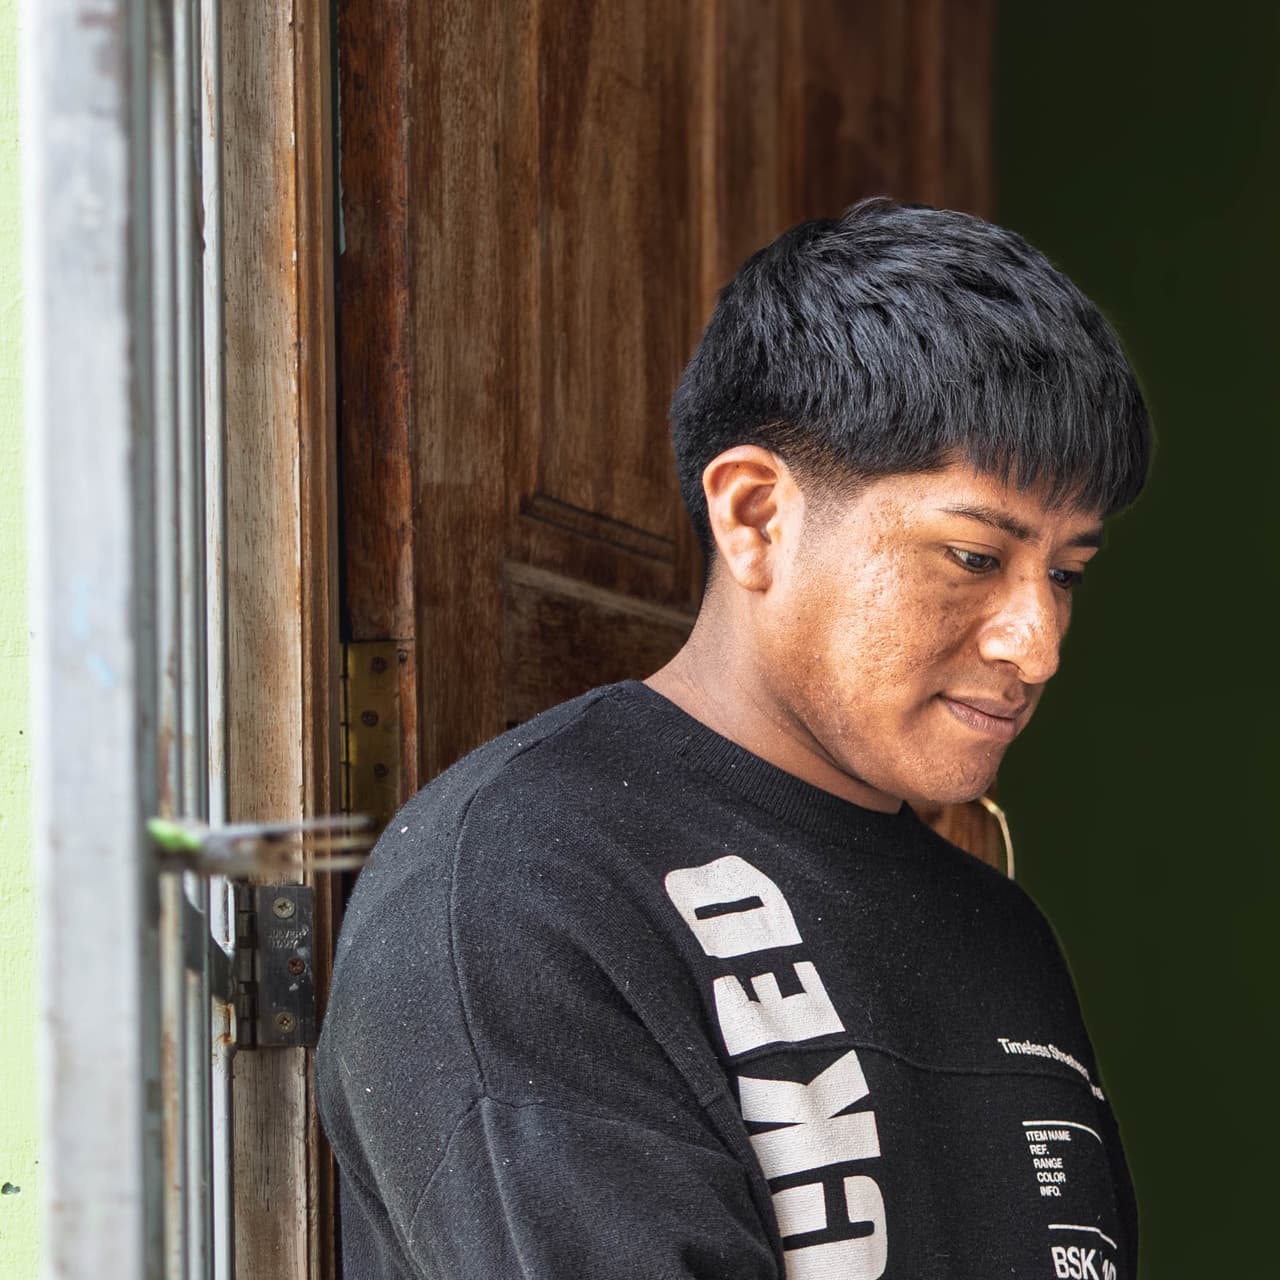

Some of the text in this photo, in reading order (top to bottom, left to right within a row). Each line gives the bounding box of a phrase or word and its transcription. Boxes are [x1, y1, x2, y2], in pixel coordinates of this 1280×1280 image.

[997, 1037, 1052, 1058] Timeless
[1025, 1129, 1072, 1142] ITEM NAME
[1029, 1143, 1050, 1155] REF.
[1033, 1157, 1064, 1169] RANGE
[1036, 1171, 1067, 1183] COLOR
[1039, 1185, 1062, 1197] INFO.
